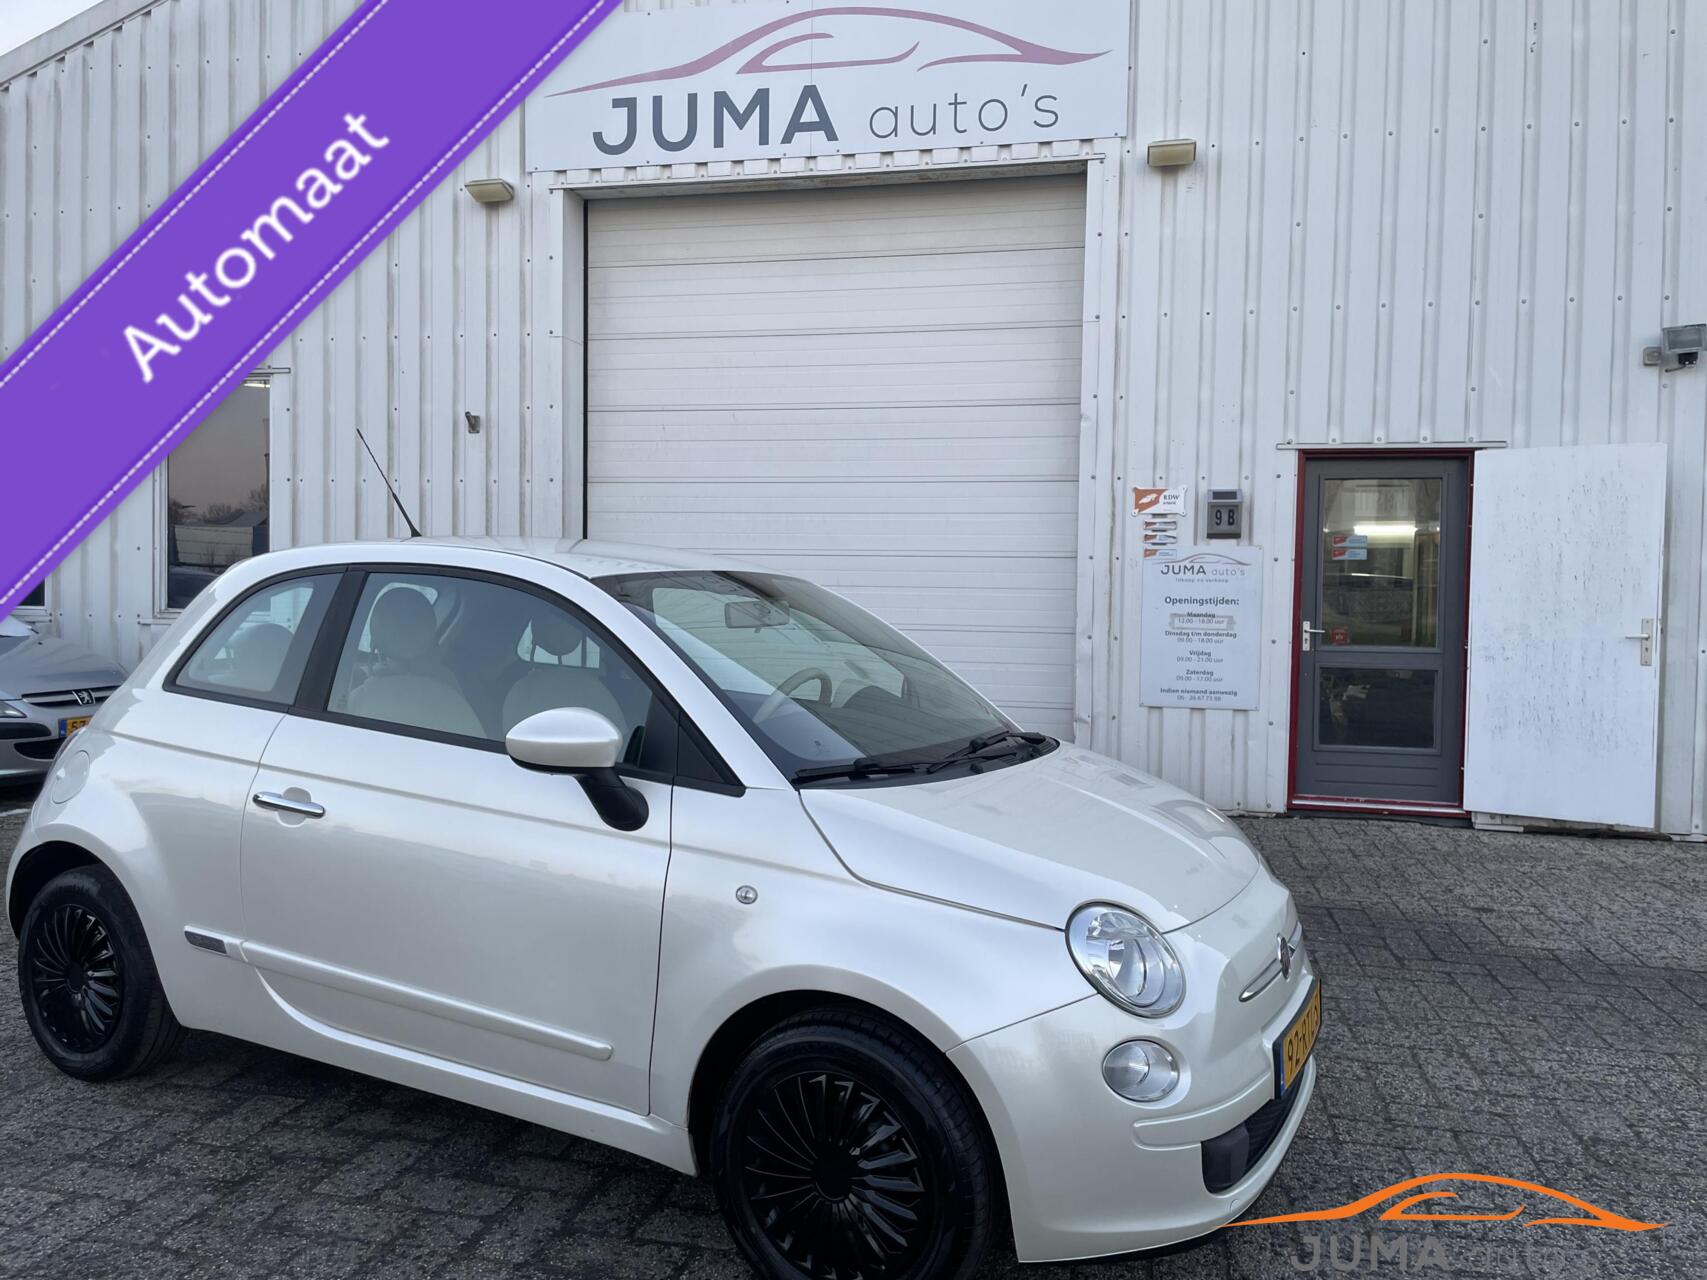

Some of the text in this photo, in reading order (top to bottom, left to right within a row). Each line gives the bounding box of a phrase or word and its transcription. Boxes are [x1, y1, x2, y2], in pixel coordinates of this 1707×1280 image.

[592, 84, 1060, 156] JUMA auto's
[1215, 509, 1235, 526] 9 B
[1160, 565, 1245, 576] JUMA auto's
[1164, 596, 1240, 607] Openingstijden:
